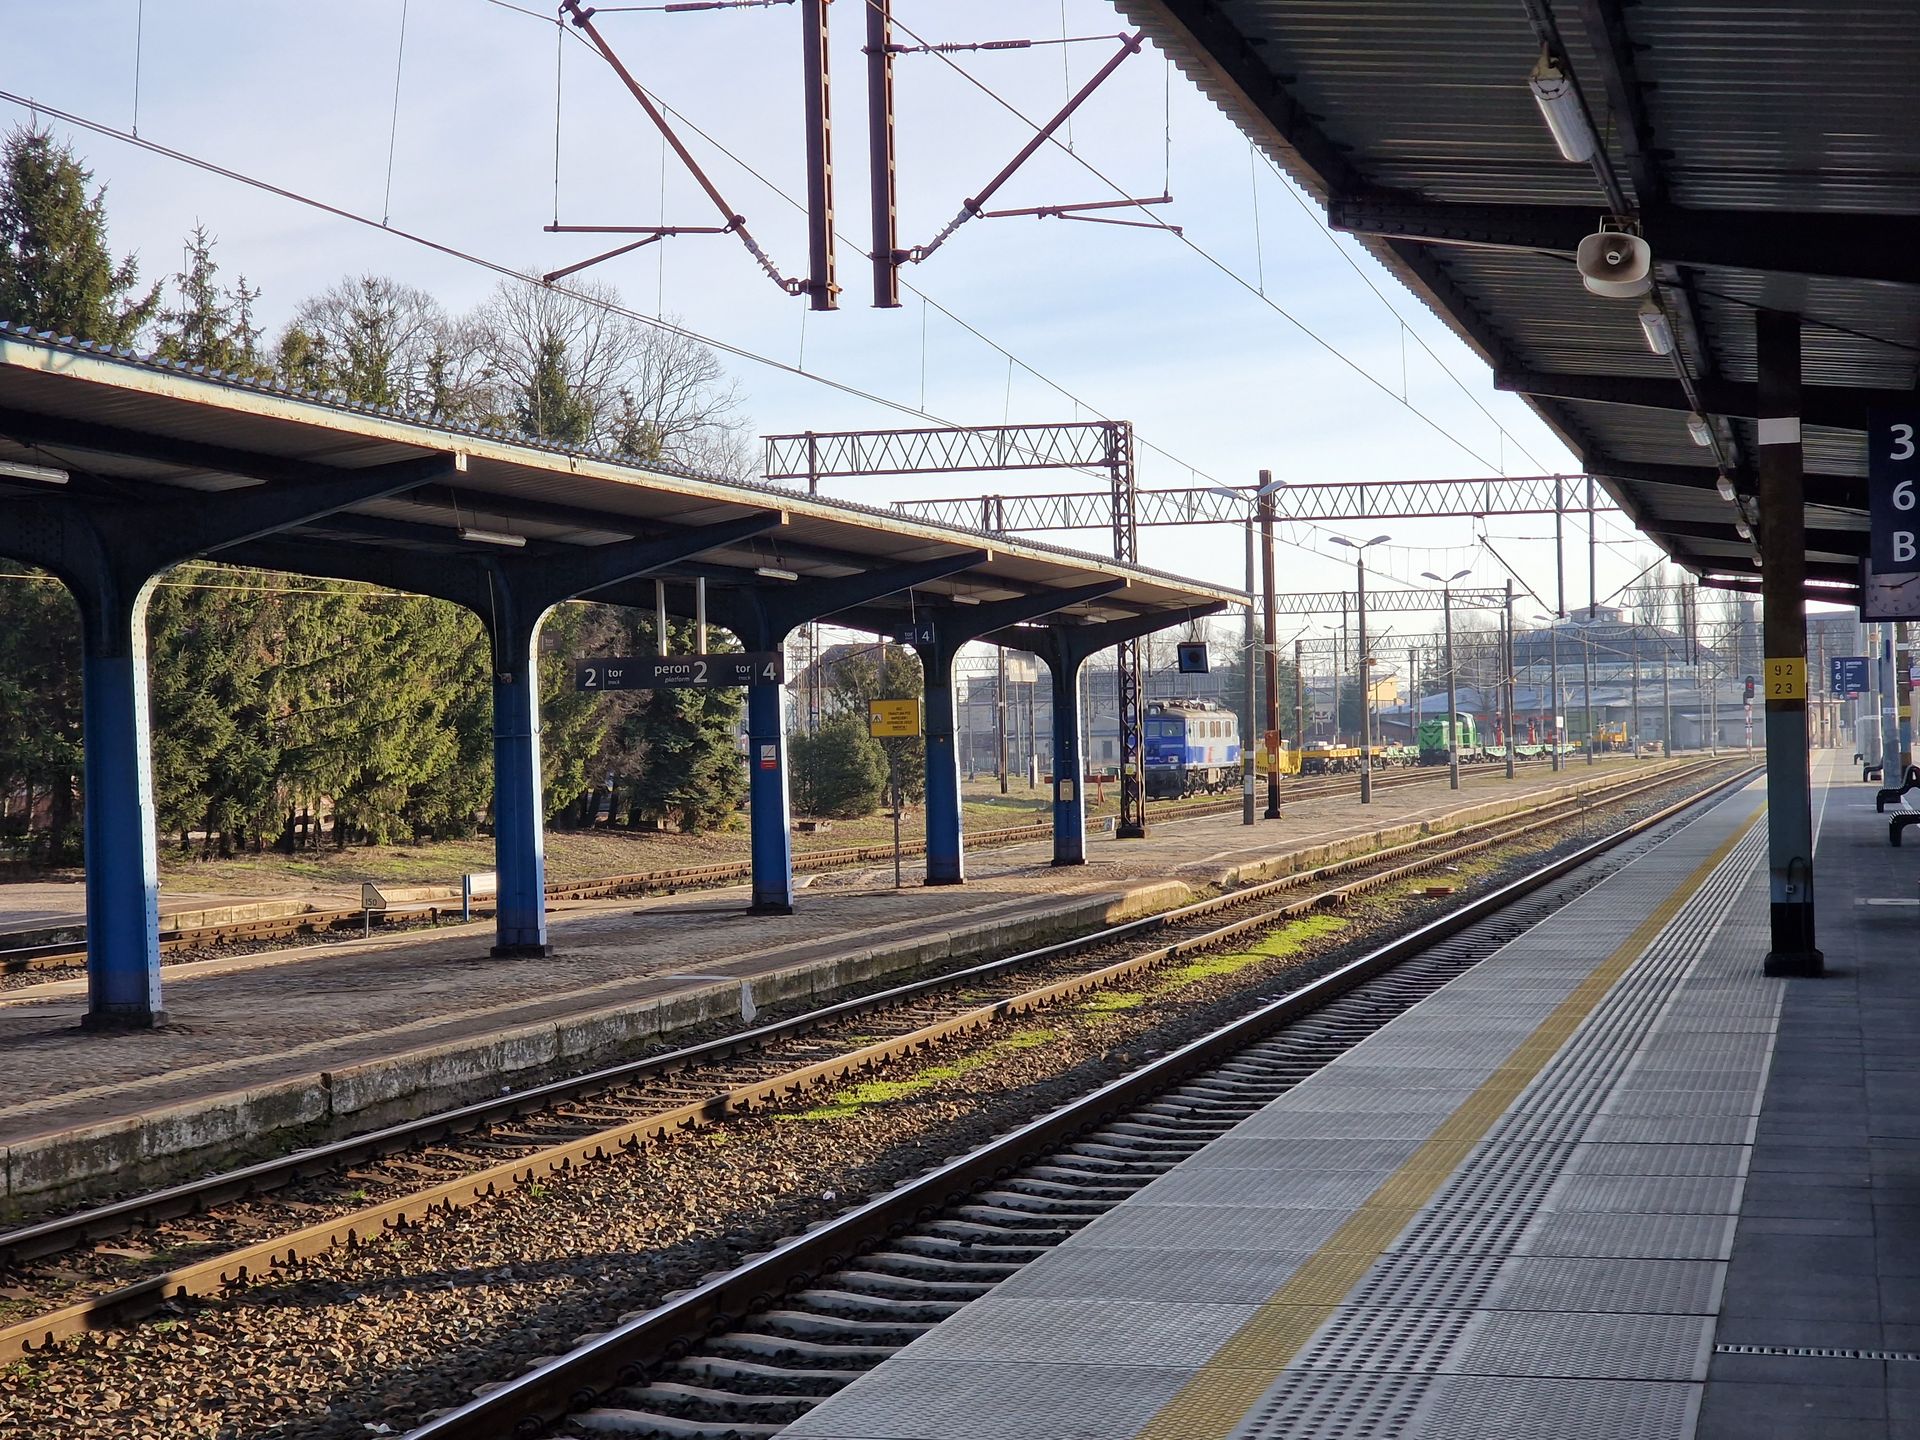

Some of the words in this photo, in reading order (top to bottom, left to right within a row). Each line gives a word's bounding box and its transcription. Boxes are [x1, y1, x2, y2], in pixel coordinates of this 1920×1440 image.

[1890, 423, 1915, 461] 3
[1892, 480, 1916, 511] 6
[1893, 531, 1917, 562] B
[921, 631, 930, 641] 4
[654, 664, 690, 677] peron
[693, 661, 708, 683] 2
[735, 665, 751, 673] tor
[762, 662, 777, 681] 4
[1834, 661, 1841, 669] 3
[584, 668, 597, 687] 2
[608, 668, 623, 678] tor
